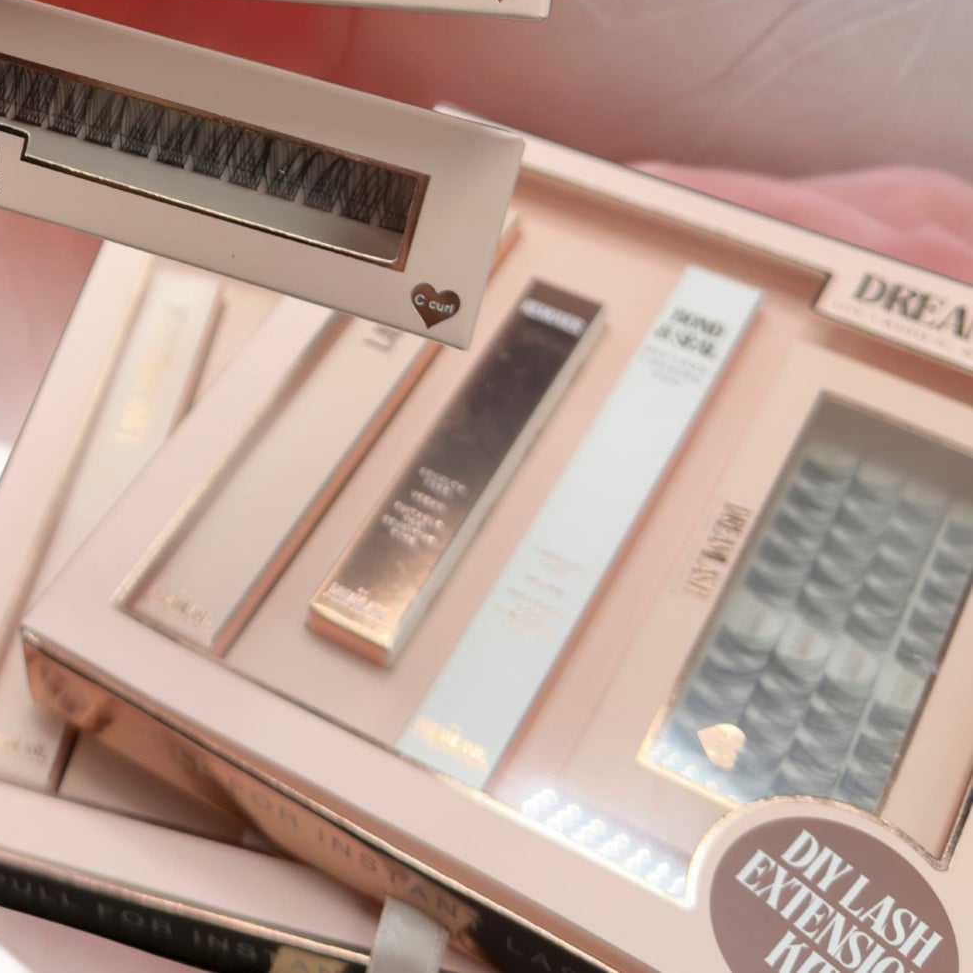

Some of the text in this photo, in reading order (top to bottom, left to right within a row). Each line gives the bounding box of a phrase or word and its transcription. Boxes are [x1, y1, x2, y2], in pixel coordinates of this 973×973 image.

[414, 293, 455, 314] C curl
[852, 273, 973, 340] DREA
[780, 828, 944, 968] DIY LASH
